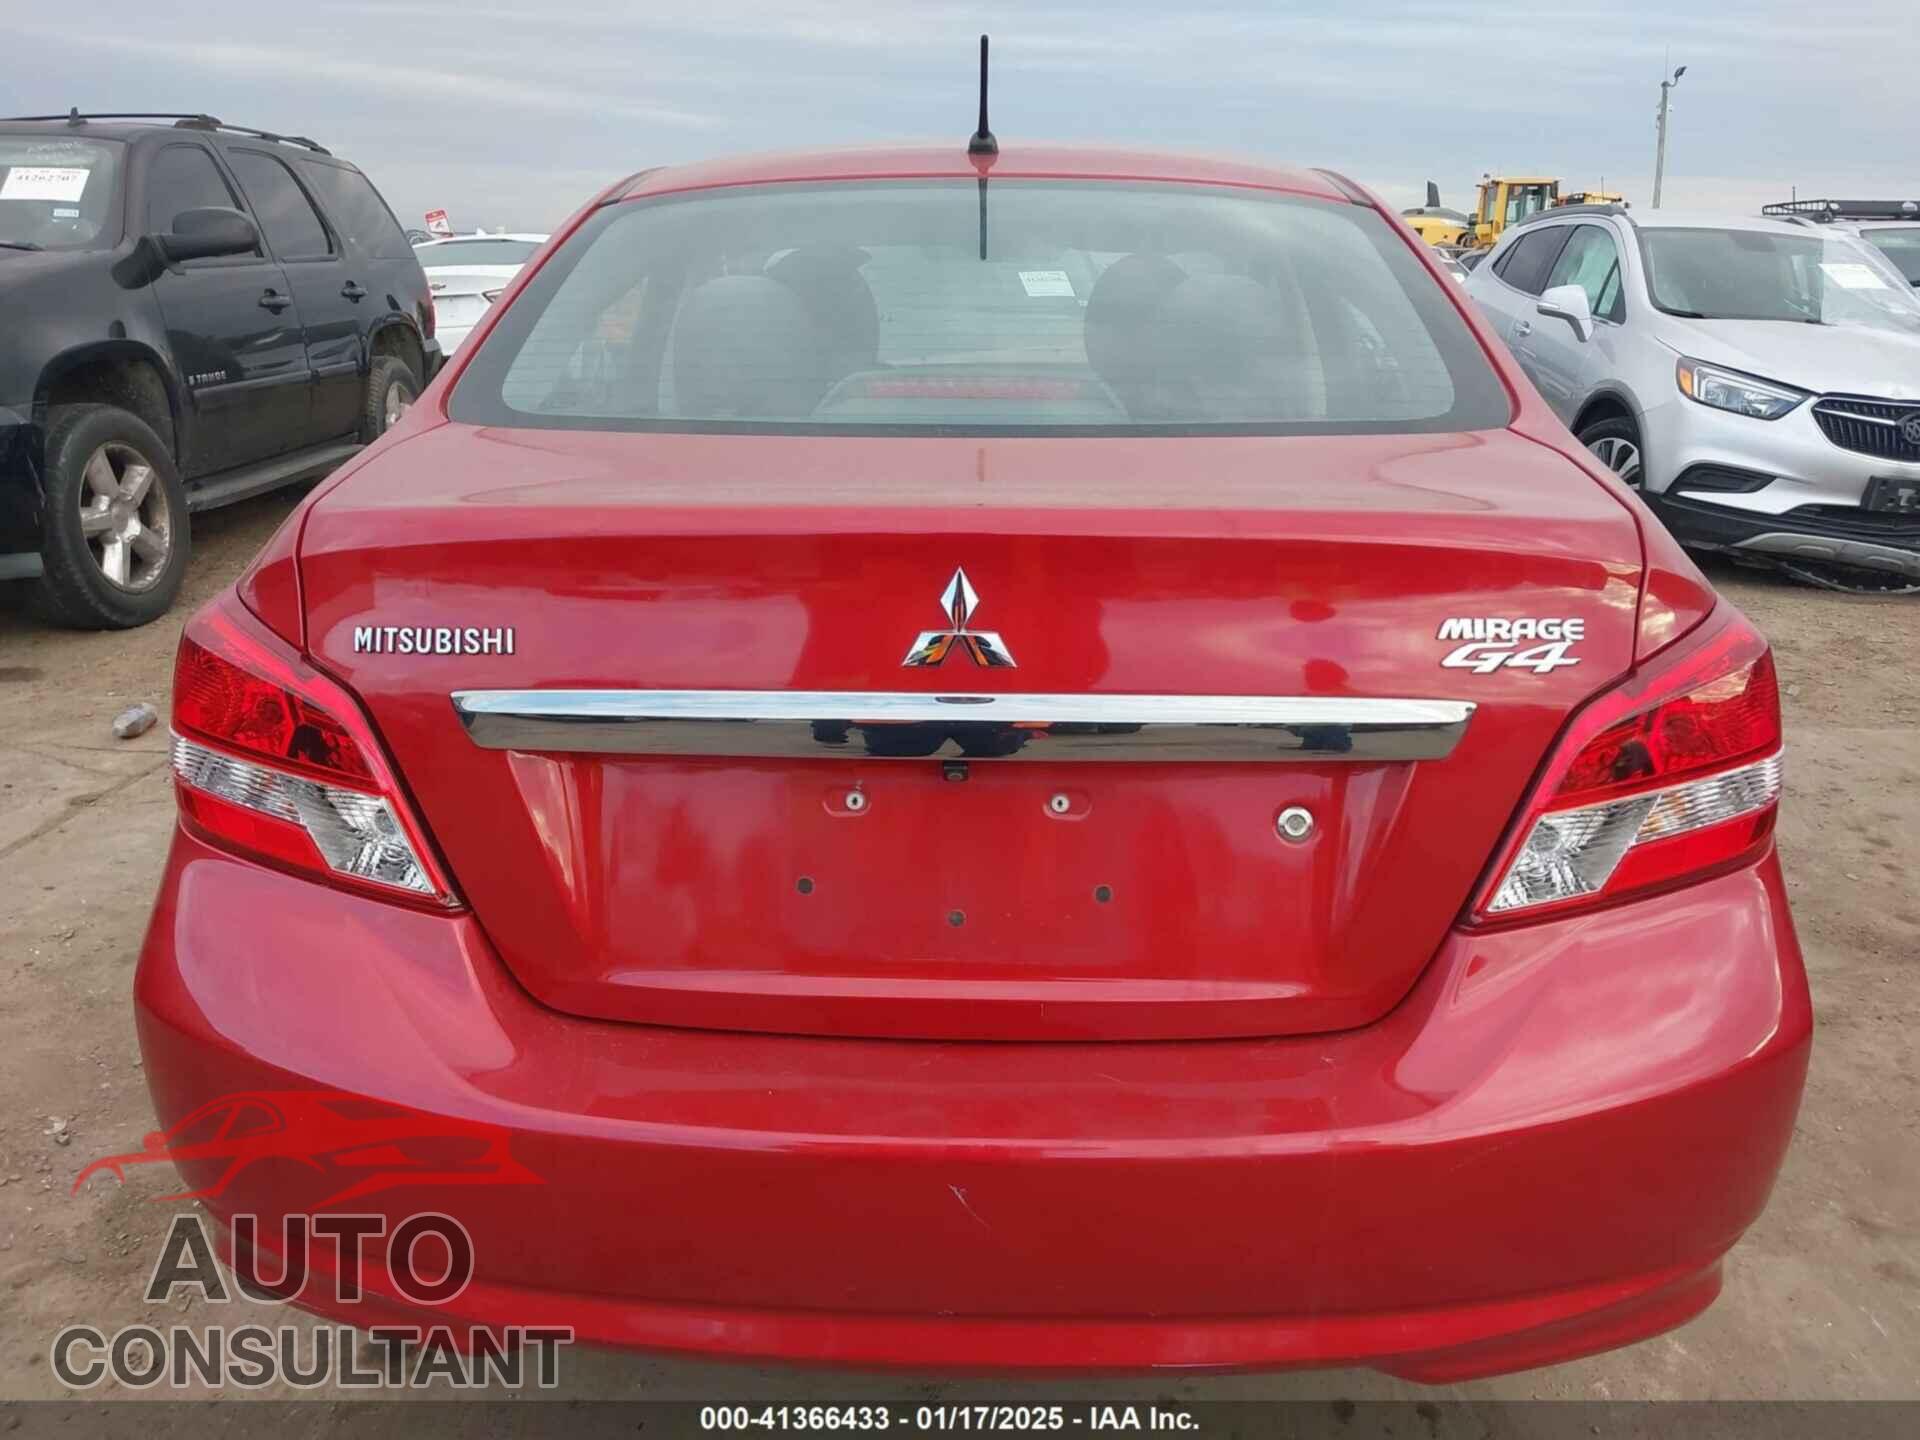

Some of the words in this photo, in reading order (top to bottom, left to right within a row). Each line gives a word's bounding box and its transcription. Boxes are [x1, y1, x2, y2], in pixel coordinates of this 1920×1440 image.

[353, 626, 515, 655] MITSUBISHI
[1437, 617, 1585, 640] MIRAGE
[1440, 640, 1582, 674] G4
